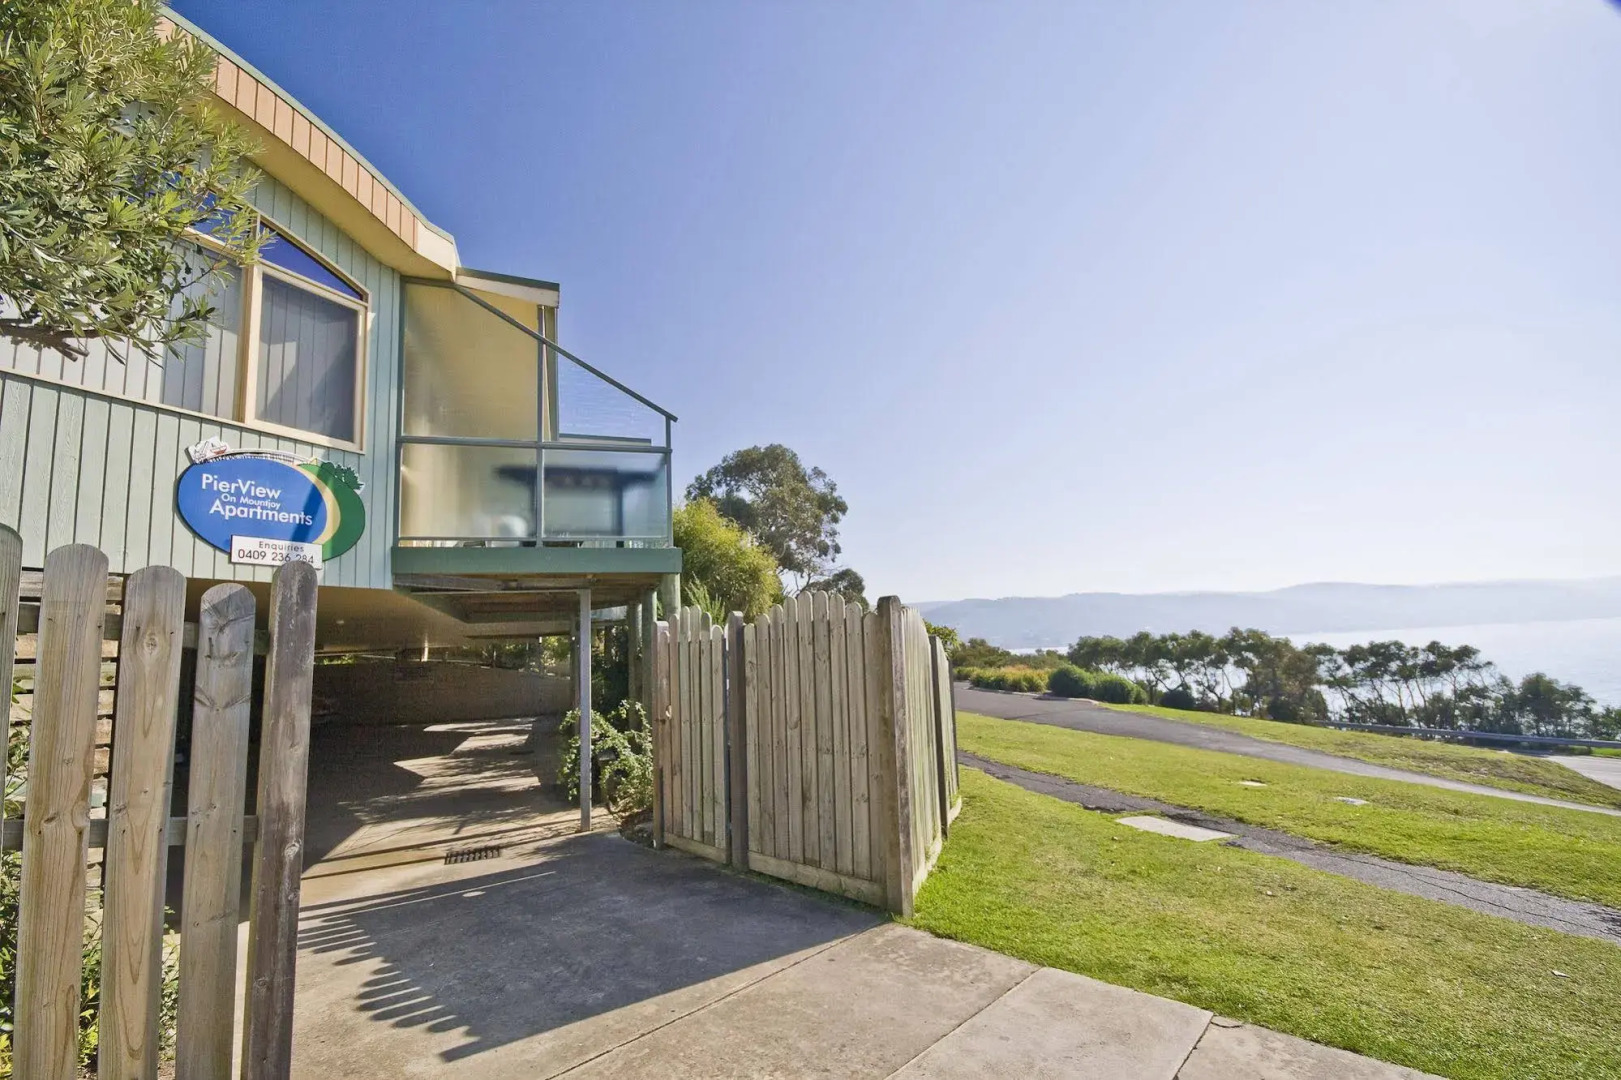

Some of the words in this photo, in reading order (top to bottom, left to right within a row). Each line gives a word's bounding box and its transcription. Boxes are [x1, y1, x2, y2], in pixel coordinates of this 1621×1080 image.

[202, 473, 281, 500] PierView
[221, 494, 236, 503] On
[240, 497, 281, 510] Mountjoy
[209, 499, 313, 526] Apartments
[258, 541, 304, 553] Enquiries
[238, 549, 267, 560] 0409
[271, 552, 291, 563] 236
